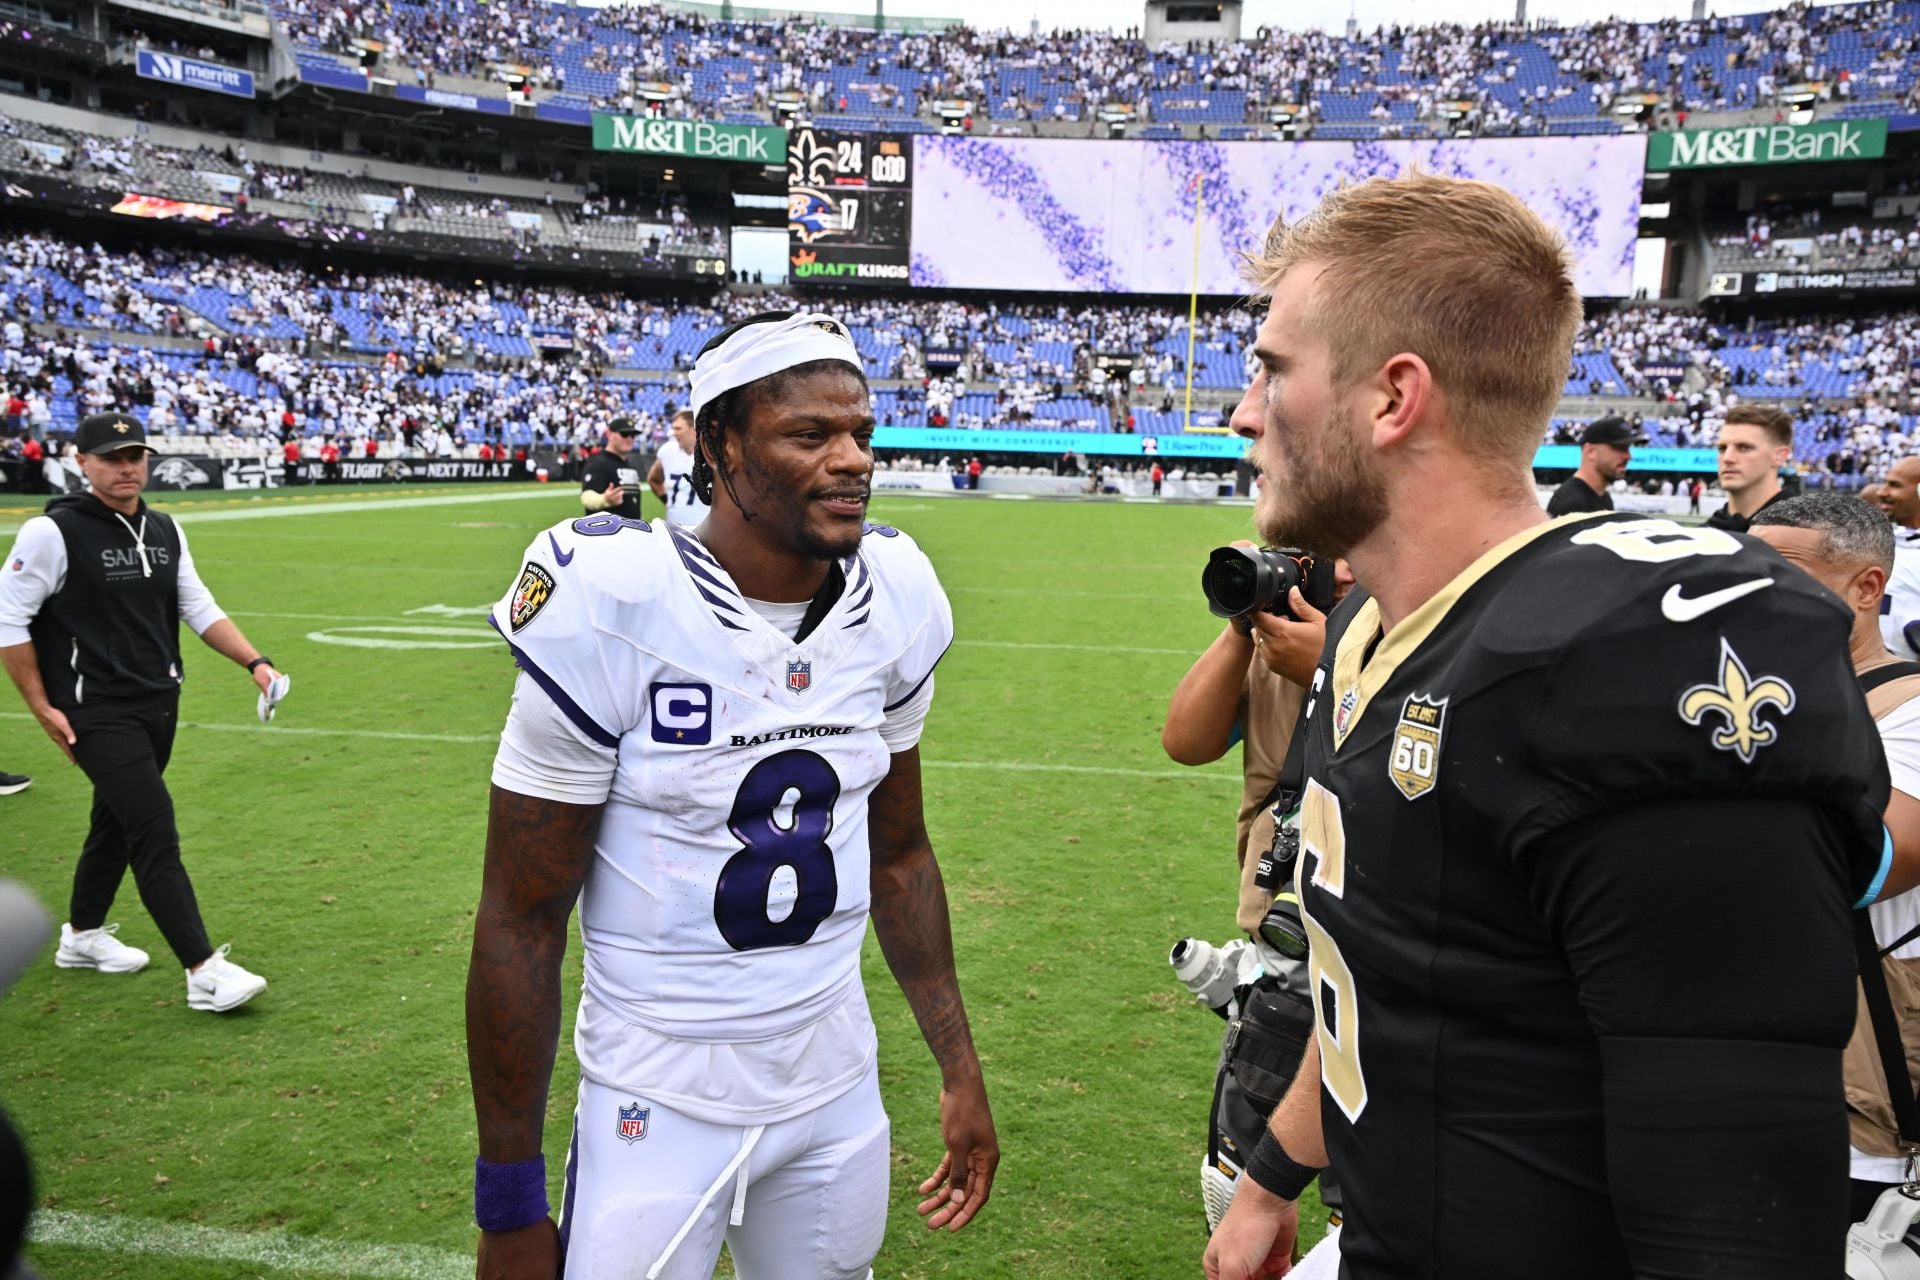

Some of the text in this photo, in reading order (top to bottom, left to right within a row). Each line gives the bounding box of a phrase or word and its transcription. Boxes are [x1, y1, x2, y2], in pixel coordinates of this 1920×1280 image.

[184, 64, 241, 87] merritt
[611, 116, 769, 160] M&T Bank
[1669, 121, 1862, 166] M&T Bank
[837, 140, 863, 173] 24
[872, 155, 906, 182] 0:00
[840, 198, 859, 231] 17
[794, 262, 909, 278] DRAFTKINGS
[1778, 274, 1844, 289] BETMGM
[925, 435, 965, 443] INVEST
[971, 436, 1000, 444] WITH
[342, 463, 383, 478] FLIGHT
[426, 463, 458, 477] NEXT
[527, 564, 553, 588] RAVENS
[789, 672, 809, 689] NFL
[655, 687, 707, 730] C
[729, 726, 856, 748] BALTIMORE
[1394, 735, 1434, 779] 60
[713, 748, 841, 951] 8
[621, 1120, 643, 1137] NFL
